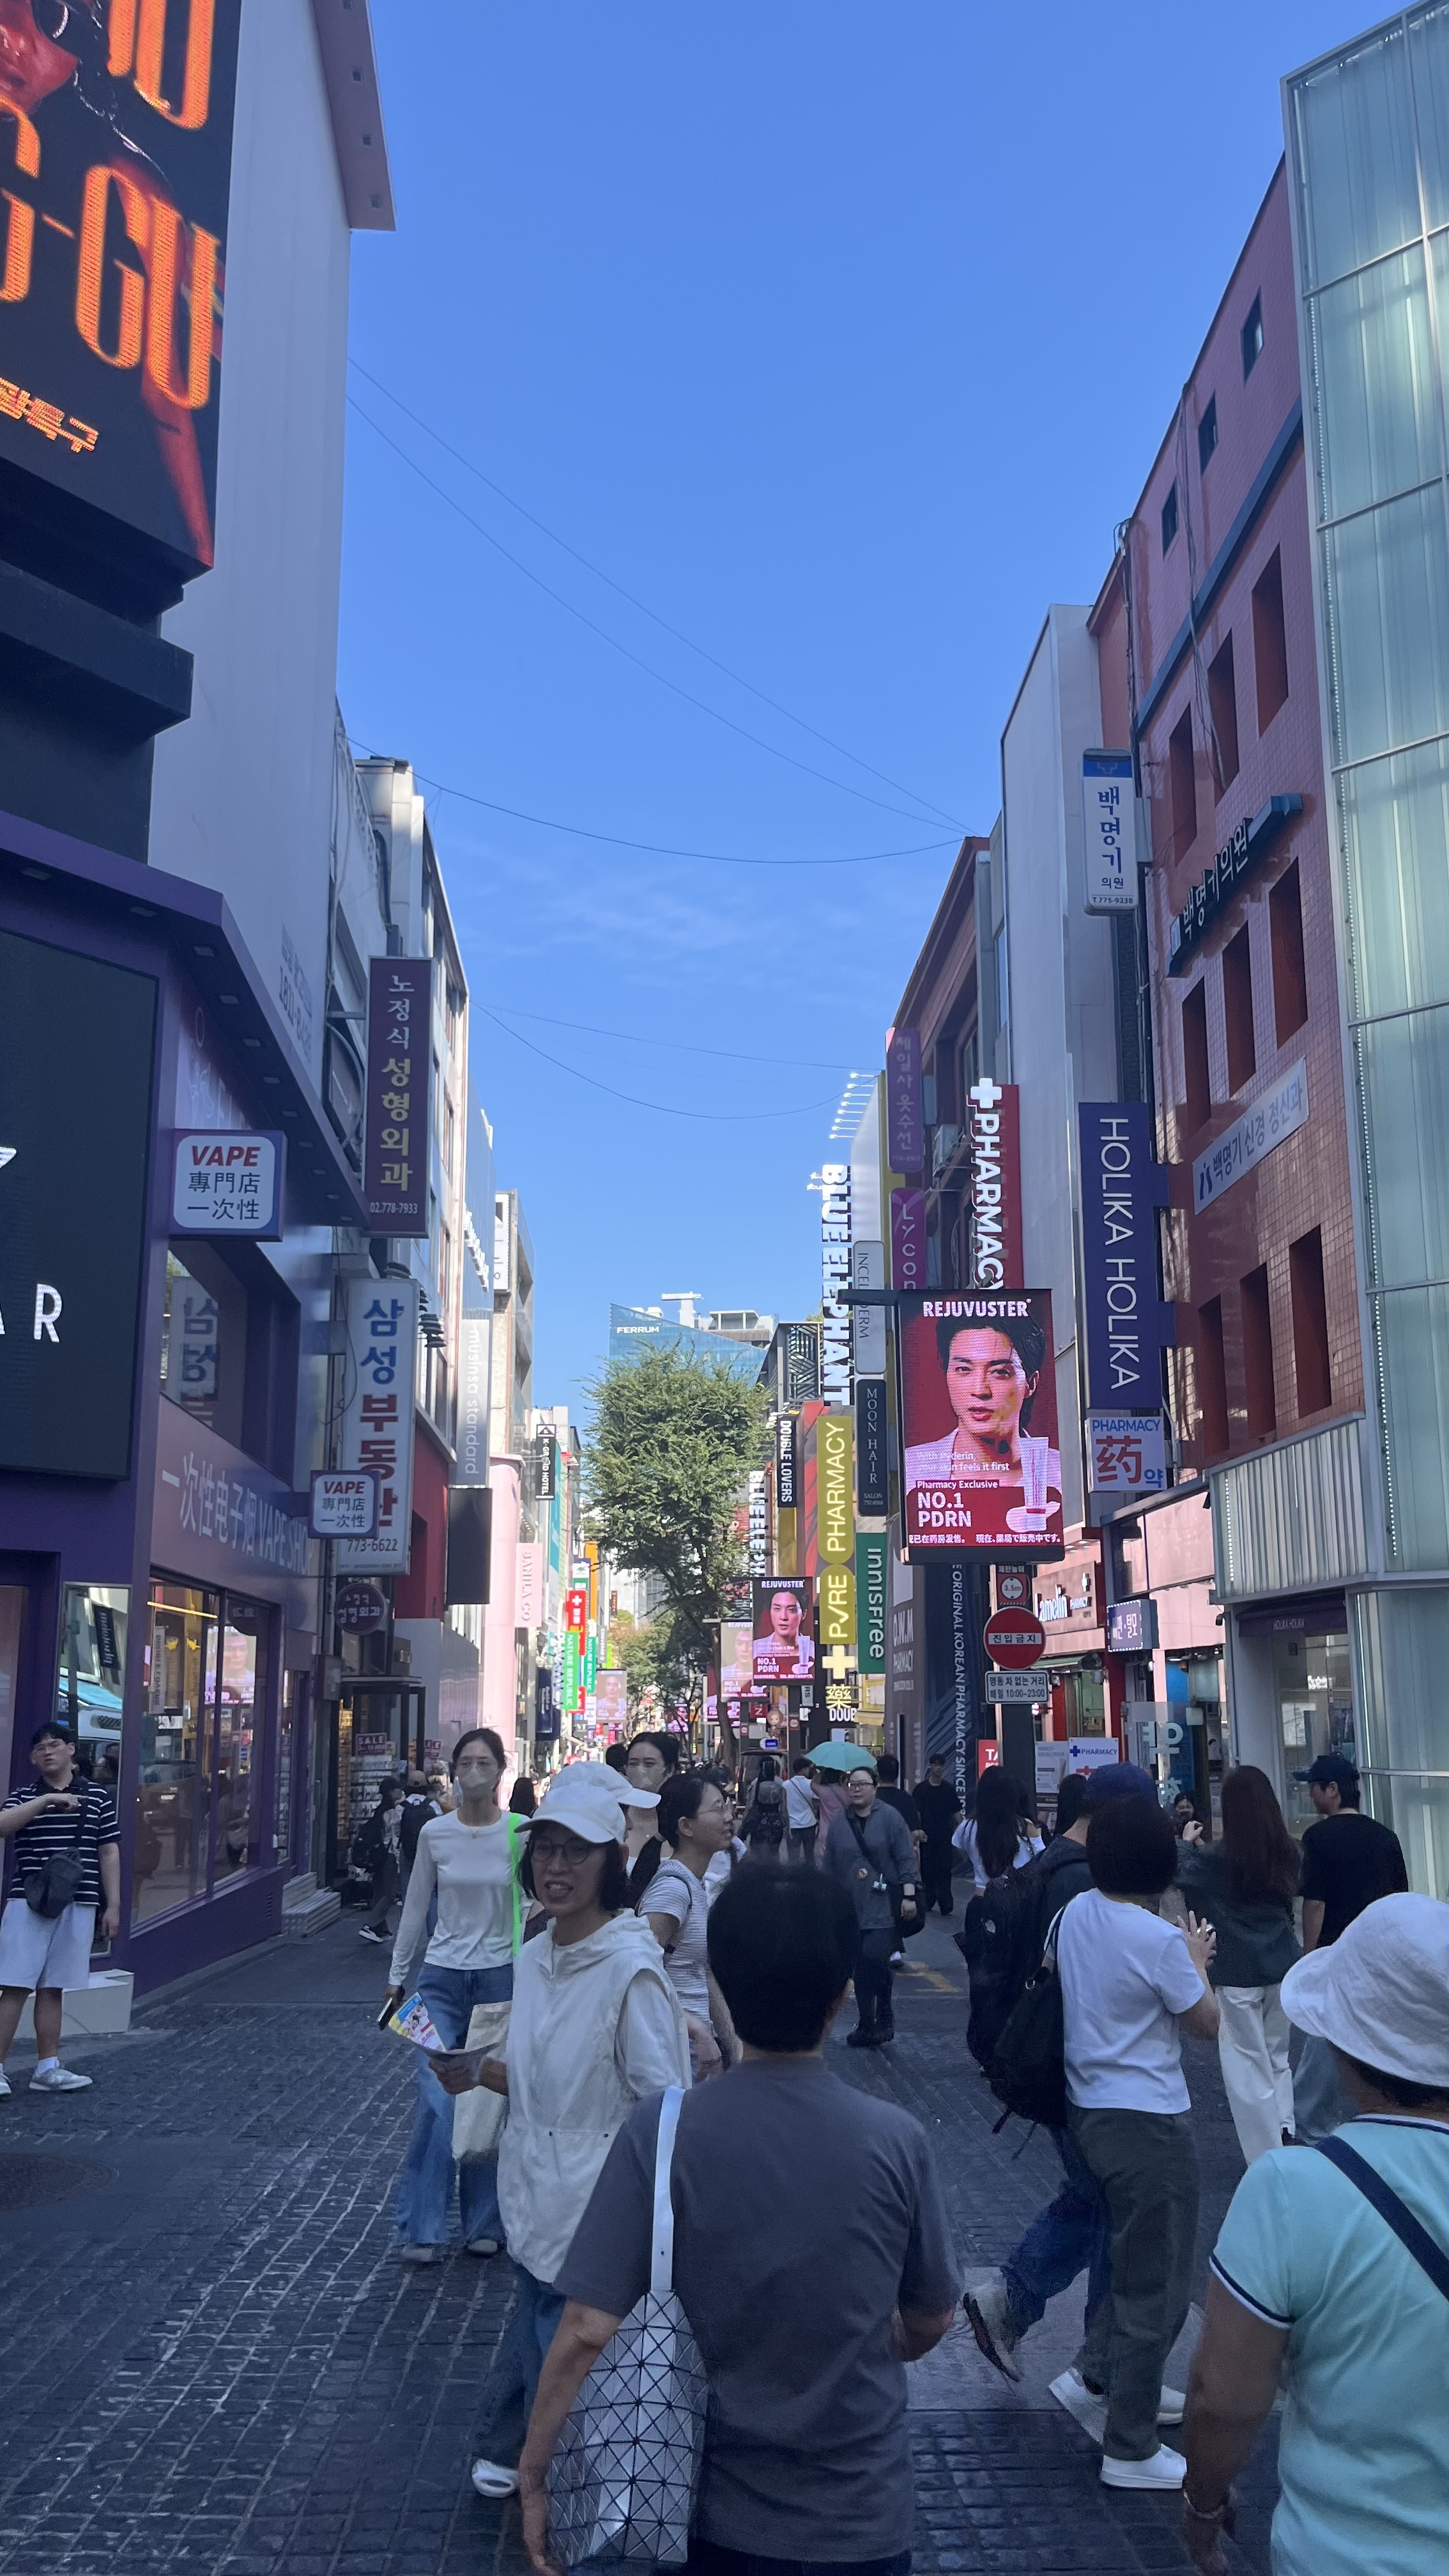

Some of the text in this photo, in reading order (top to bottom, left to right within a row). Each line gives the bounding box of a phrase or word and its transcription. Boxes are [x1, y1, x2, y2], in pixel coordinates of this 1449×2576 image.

[1098, 786, 1123, 874] 백명기
[1101, 877, 1124, 889] 의원
[1183, 818, 1250, 943] 백명기의원
[385, 975, 415, 1050] 노정식
[380, 1057, 414, 1192] 성형외과
[1243, 1115, 1266, 1154] 신경
[1268, 1080, 1303, 1135] 정신과
[192, 1146, 261, 1167] VAPE
[188, 1171, 261, 1195] 專門店
[187, 1198, 260, 1220] 一次性
[1100, 1118, 1140, 1390] HOLIKA HOLIKA
[822, 1164, 852, 1406] BLUE ELEPHANT
[857, 1253, 870, 1338] INCELERM
[923, 1301, 1029, 1317] REJUVUSTER
[617, 1326, 659, 1334] FERRUM
[465, 1328, 480, 1475] musinsa standard
[866, 1388, 878, 1484] MOON HAIR
[1091, 1419, 1162, 1432] PHARMACY
[779, 1420, 793, 1503] DOUBLE LOVERS
[991, 1461, 1010, 1471] first
[1095, 1435, 1142, 1485] 药
[323, 1481, 365, 1495] VAPE
[541, 1473, 549, 1495] HOTEL
[825, 1422, 847, 1552] PHARMACY
[917, 1480, 999, 1490] Pharmacy Exclusive
[1143, 1468, 1164, 1487] 약
[322, 1497, 366, 1512] 專門店
[917, 1492, 964, 1508] NO.1
[321, 1514, 365, 1528] 一次性
[918, 1510, 972, 1528] PDRN
[348, 1538, 398, 1552] 773-6622
[522, 1549, 533, 1599] BANILA
[761, 1580, 804, 1588] REJUVUSTER
[868, 1548, 885, 1659] innisfree
[952, 1570, 963, 1630] ORIGINAL
[1035, 1584, 1068, 1622] Lamelin
[1273, 1618, 1305, 1630] HOLIKA HOLIKA
[993, 1634, 1036, 1644] 진입금지
[954, 1632, 965, 1683] KOREAN
[565, 1667, 574, 1706] REPUBLIC
[1031, 1676, 1045, 1686] 거리
[825, 1683, 852, 1711] 藥
[829, 1707, 857, 1722] DOUB
[955, 1685, 966, 1756] PHARMACY
[358, 1735, 385, 1745] SALE
[955, 1758, 966, 1793] SINCE
